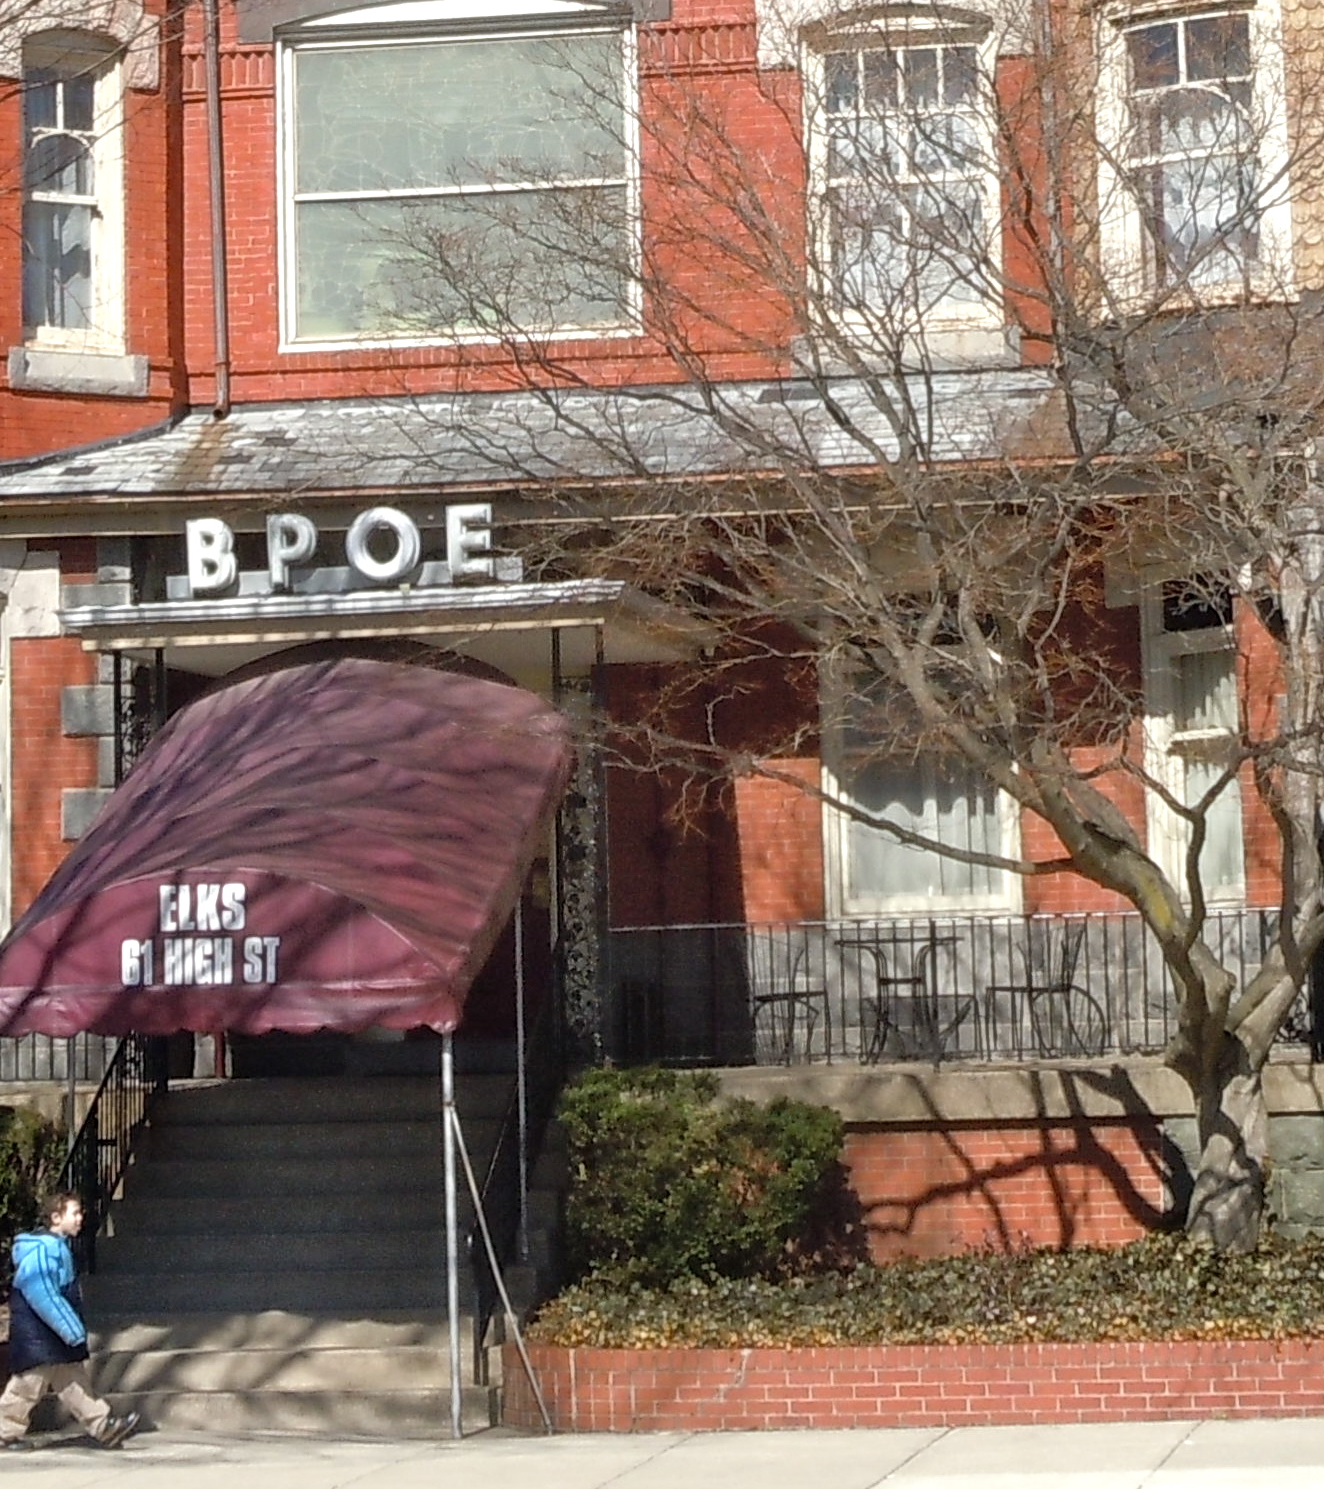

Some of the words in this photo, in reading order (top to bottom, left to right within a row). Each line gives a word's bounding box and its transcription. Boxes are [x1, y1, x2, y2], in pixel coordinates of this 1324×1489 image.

[159, 883, 246, 932] ELKS
[121, 939, 153, 986] 61
[164, 937, 233, 985] HIGH
[243, 936, 280, 984] ST
